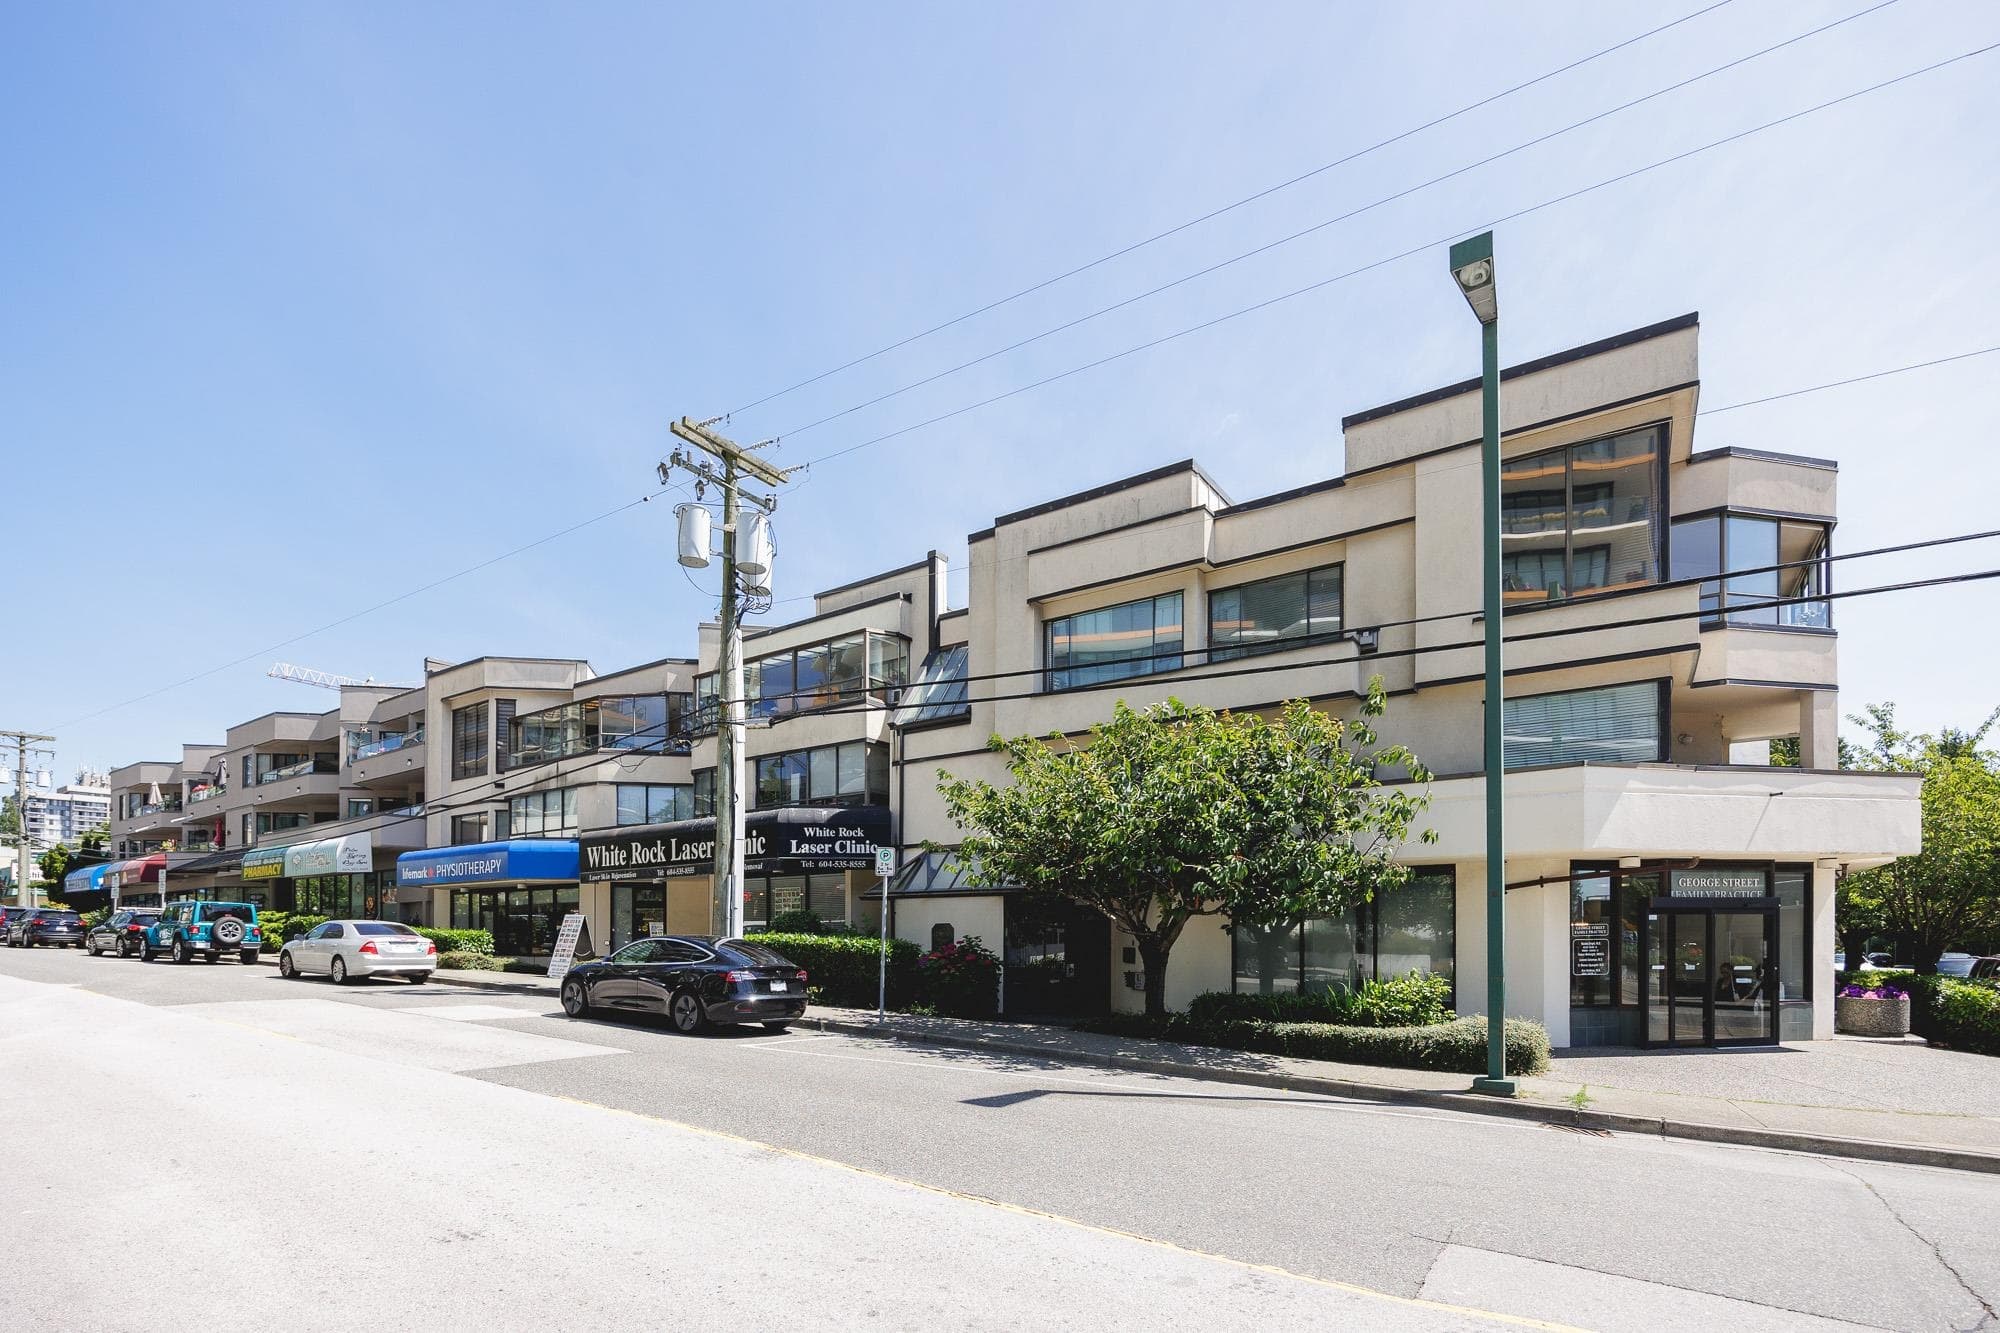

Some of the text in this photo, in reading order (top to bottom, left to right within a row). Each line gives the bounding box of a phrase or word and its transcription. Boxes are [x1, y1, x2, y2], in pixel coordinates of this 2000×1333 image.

[804, 827, 865, 837] White Rock
[587, 830, 766, 868] White Rock Laser nic
[790, 839, 878, 854] Laser Clinic
[243, 863, 282, 879] PHARMACY
[402, 859, 502, 880] lifemark PHYSIOTHERAPY
[800, 860, 866, 868] Tel: 604-535-8555
[1679, 877, 1760, 887] GEORGE STREET
